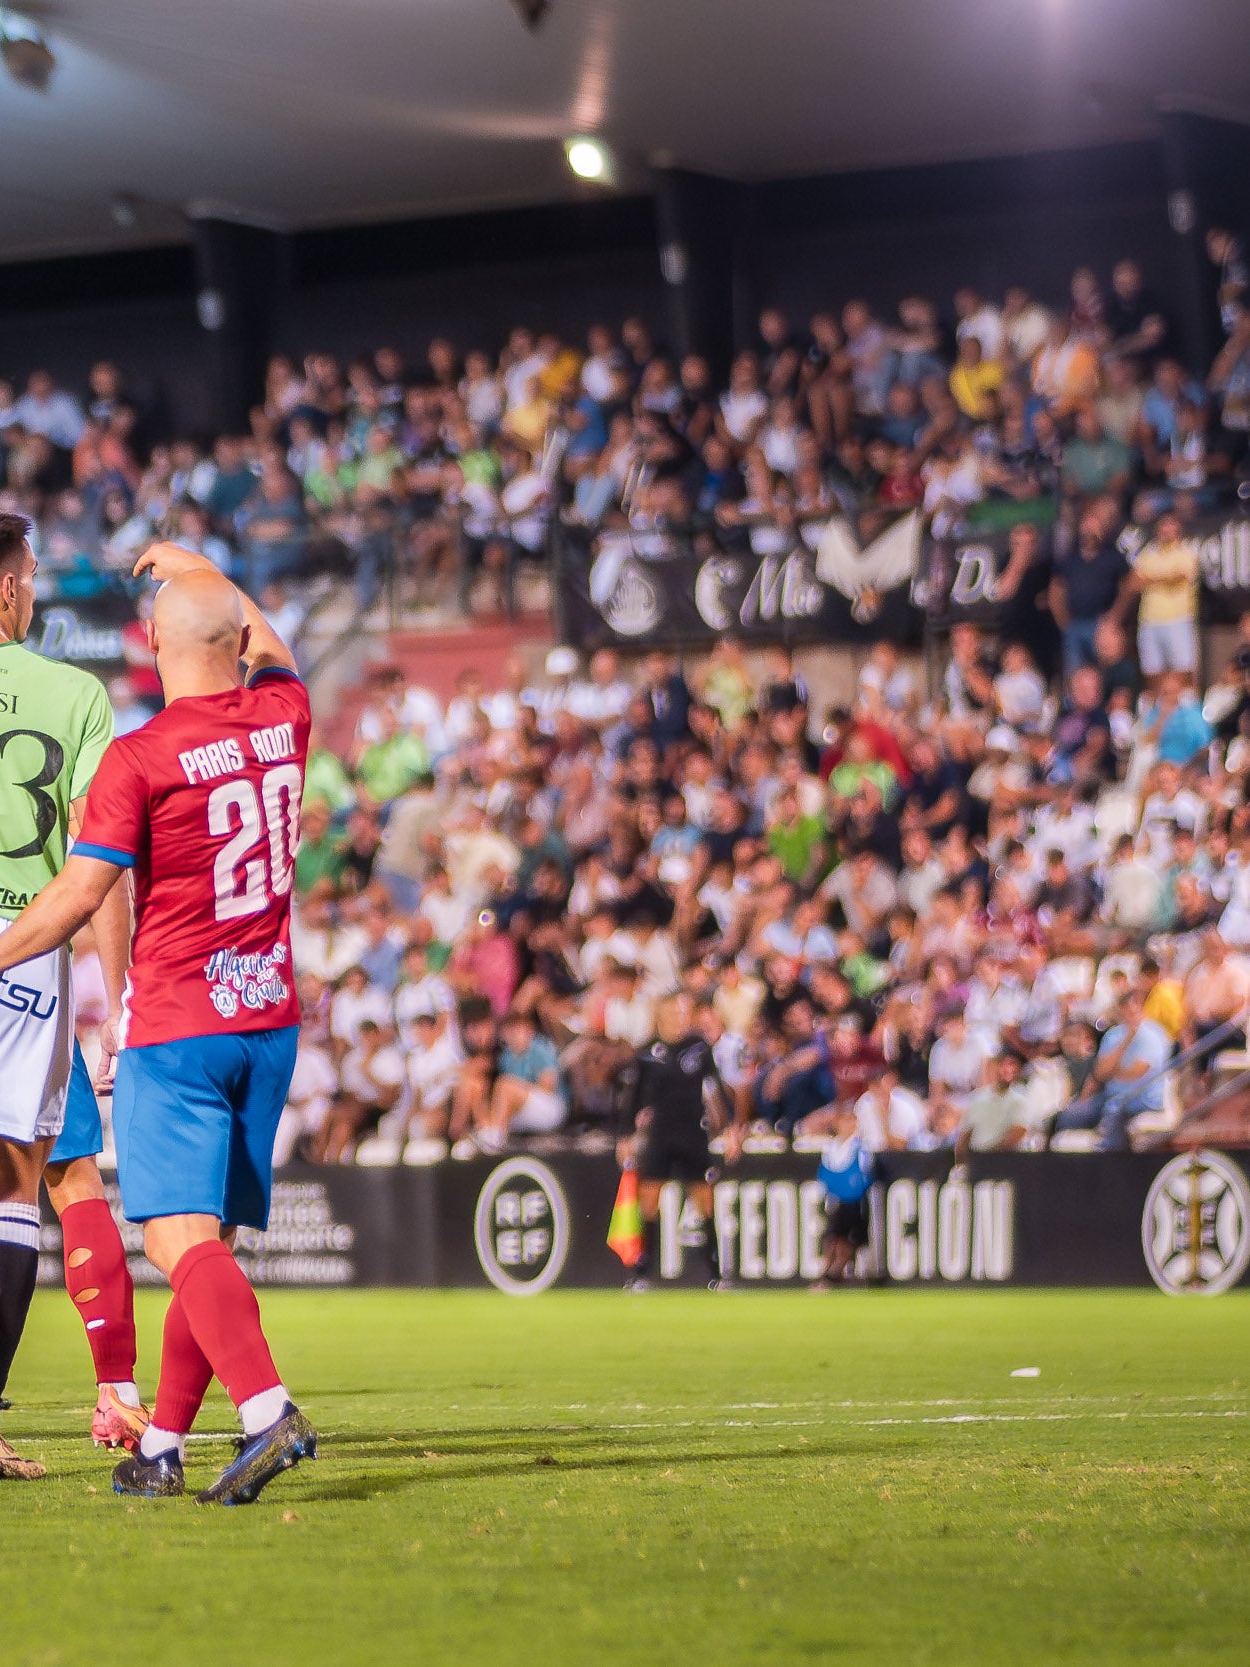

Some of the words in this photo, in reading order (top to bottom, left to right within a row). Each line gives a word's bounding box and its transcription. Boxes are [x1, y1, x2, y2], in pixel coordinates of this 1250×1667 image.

[178, 738, 245, 785] PARIS
[208, 763, 302, 922] 20
[204, 945, 287, 990] Algeciras
[494, 1191, 548, 1226] RF
[713, 1164, 1018, 1281] FEDEACIÓN
[495, 1229, 548, 1265] EF
